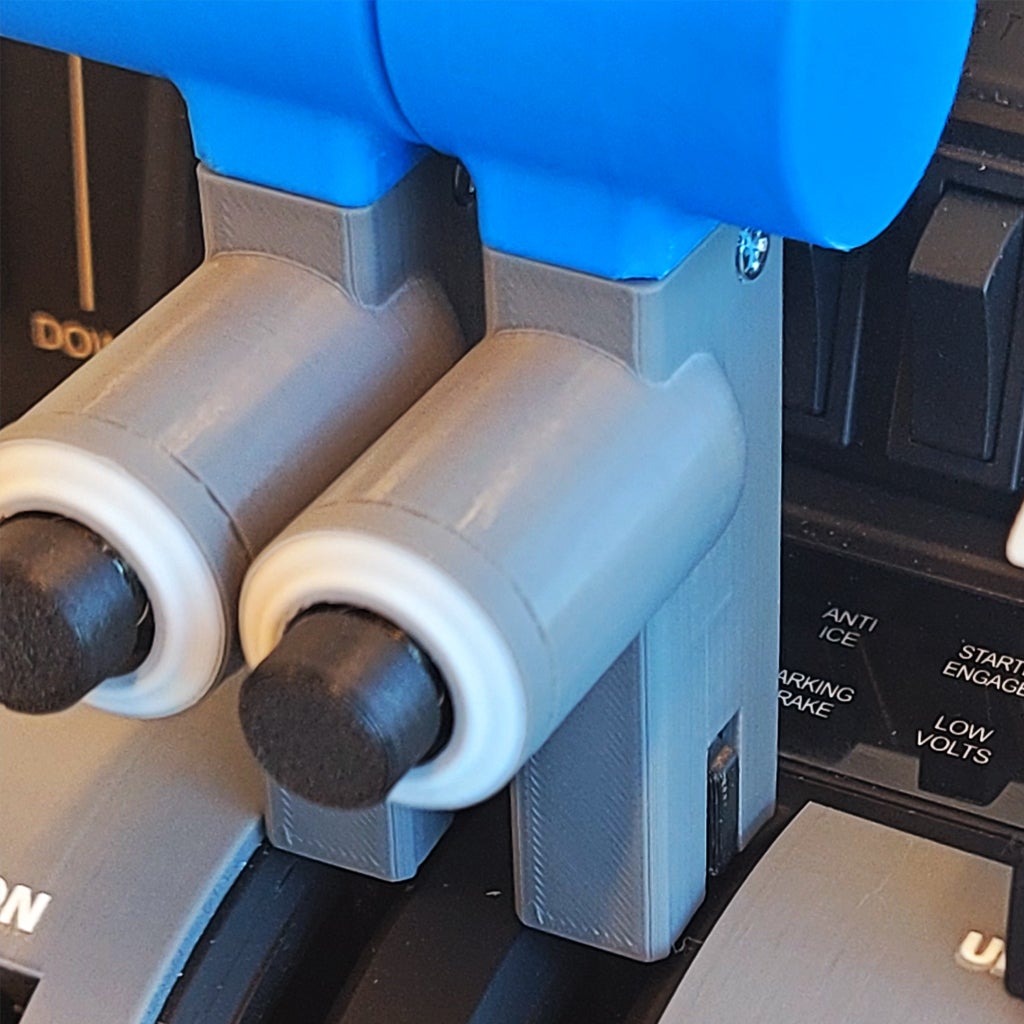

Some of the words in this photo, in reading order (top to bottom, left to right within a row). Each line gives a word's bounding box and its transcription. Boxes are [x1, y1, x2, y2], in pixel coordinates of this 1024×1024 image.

[32, 311, 113, 359] DO
[821, 607, 879, 632] ANTI
[818, 625, 861, 648] ICE
[778, 669, 855, 702] ARKING
[778, 689, 835, 719] RAKE
[934, 715, 995, 743] LOW
[915, 729, 992, 765] VOLTS
[959, 930, 1007, 977] U
